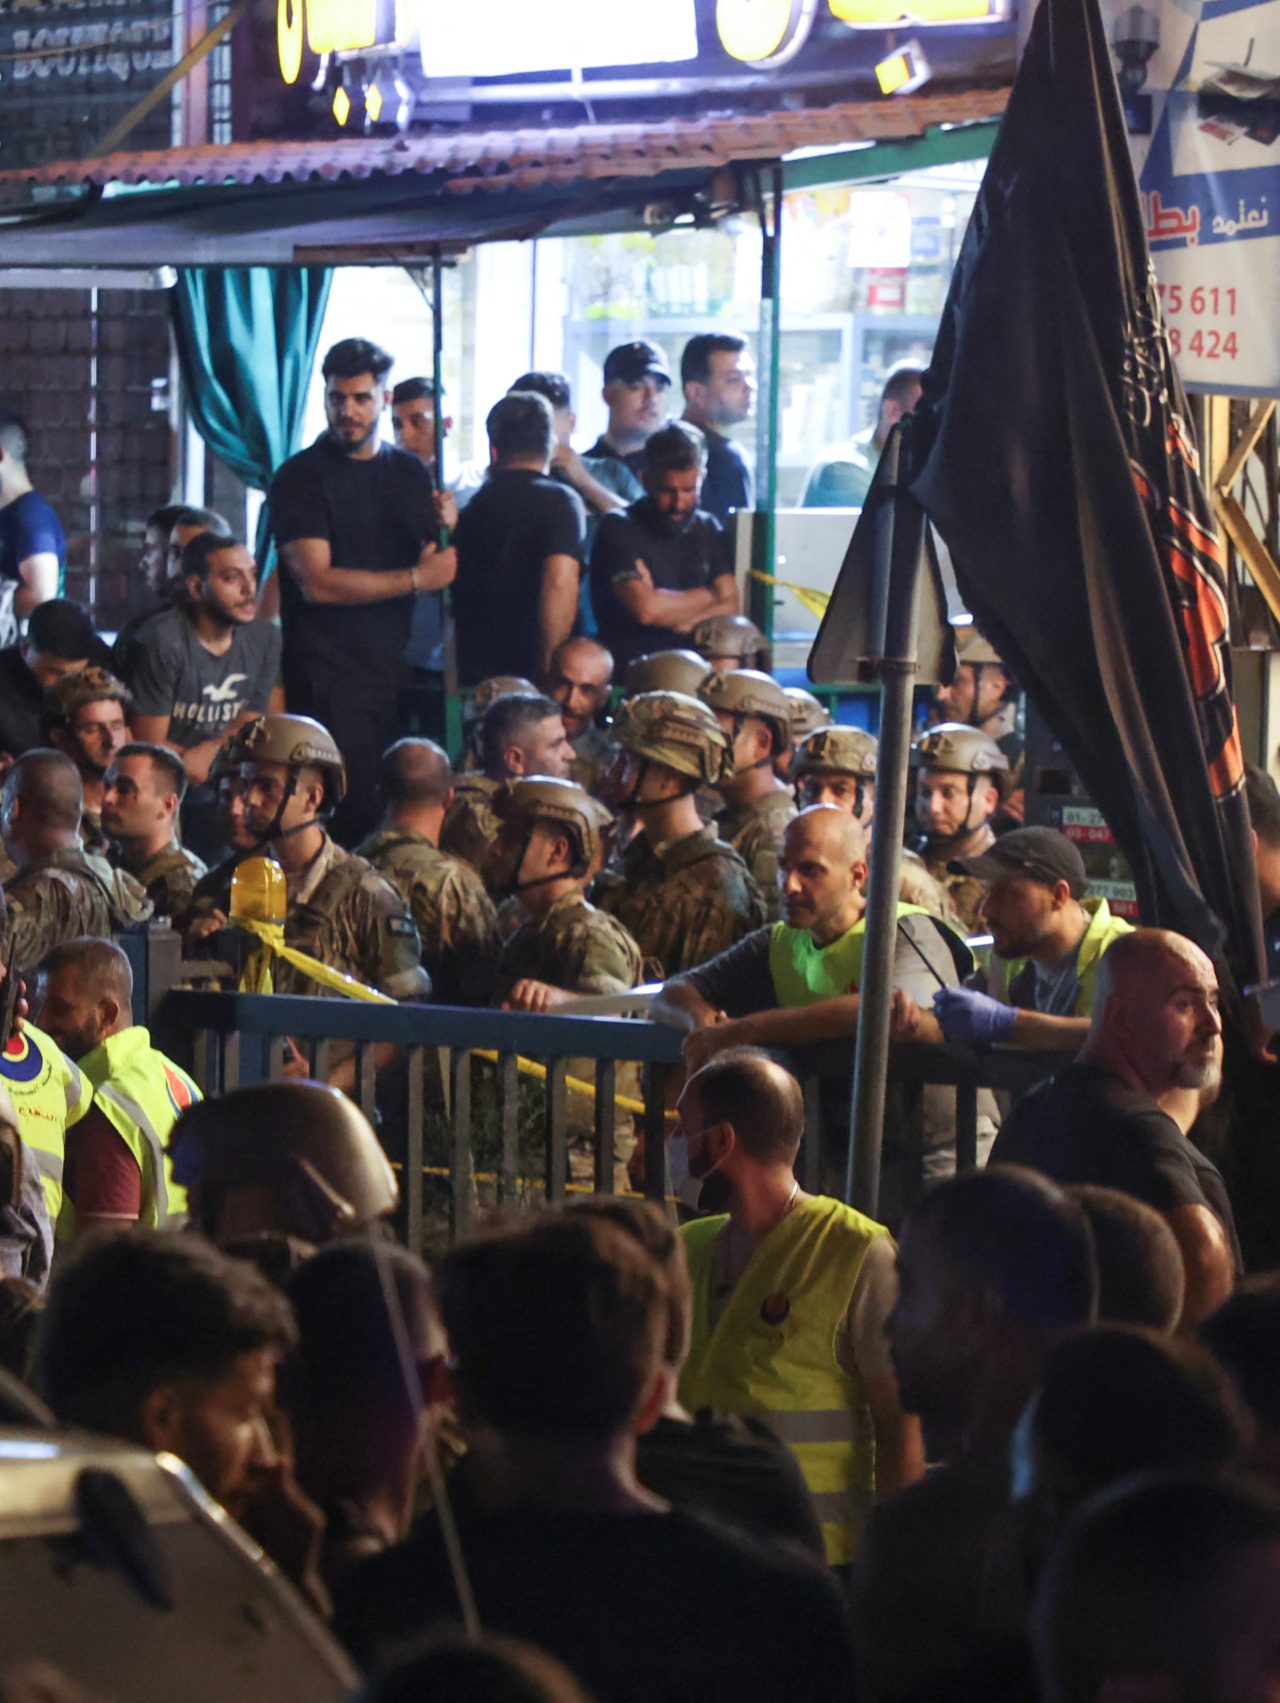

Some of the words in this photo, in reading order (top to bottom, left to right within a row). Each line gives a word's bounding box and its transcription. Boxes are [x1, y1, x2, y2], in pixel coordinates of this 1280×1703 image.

[1213, 197, 1268, 236] نعتمد
[1190, 287, 1237, 316] 611
[1189, 330, 1238, 360] 424
[173, 701, 243, 722] HOLLIST
